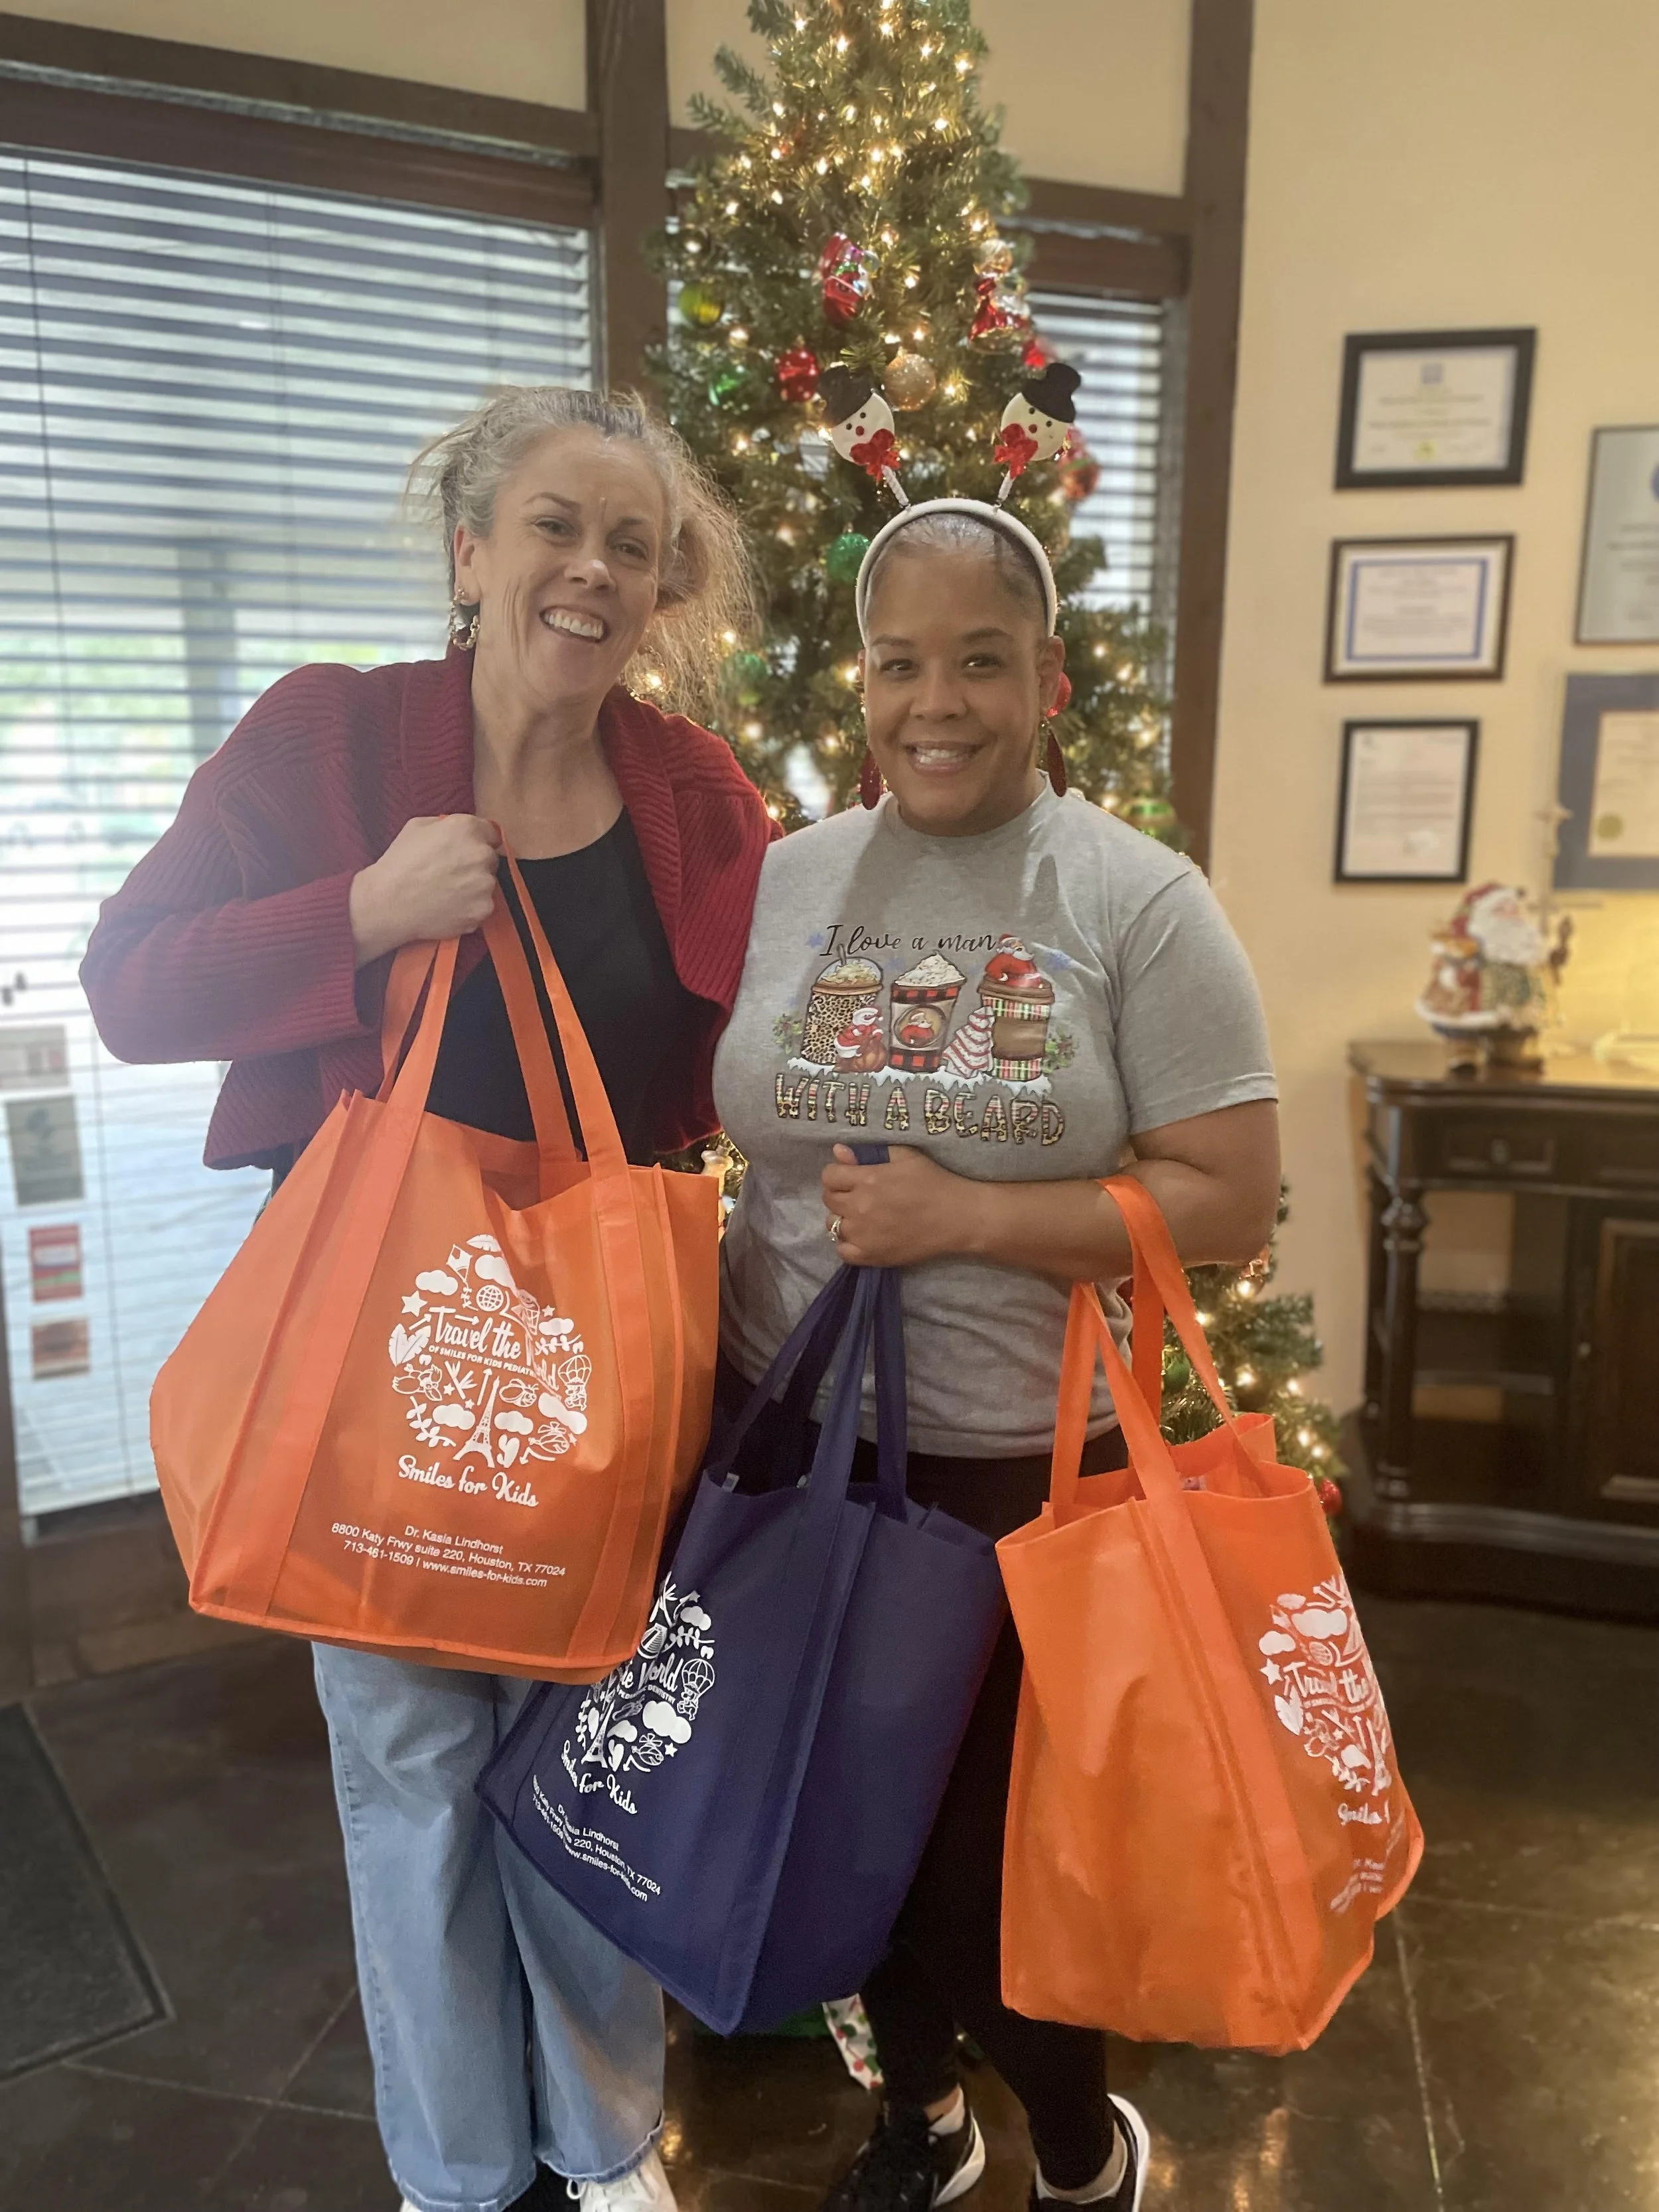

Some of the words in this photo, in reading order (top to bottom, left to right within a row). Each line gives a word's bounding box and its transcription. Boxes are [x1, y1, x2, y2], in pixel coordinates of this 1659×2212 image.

[819, 924, 847, 956] I
[847, 925, 902, 955] love
[912, 934, 928, 949] a
[938, 932, 996, 952] man
[774, 1072, 871, 1126] WITH
[885, 1087, 910, 1131] A
[924, 1088, 1065, 1146] BEARD
[429, 1306, 493, 1353] Travel
[492, 1321, 522, 1359] the
[439, 1347, 466, 1359] SMILES
[467, 1353, 483, 1364] FOR
[484, 1358, 502, 1368] KIDS
[398, 1454, 455, 1489] Smiles
[458, 1465, 488, 1495] for
[492, 1472, 539, 1507] Kids
[332, 1522, 359, 1537] 8800
[362, 1528, 385, 1546] Katy
[386, 1536, 413, 1553] Frwy
[414, 1544, 441, 1557] suite
[443, 1549, 465, 1563] 220,
[469, 1552, 514, 1572] Houston,
[518, 1562, 533, 1573] TX
[535, 1564, 566, 1577] 77024
[405, 1525, 419, 1538] Dr.
[423, 1529, 452, 1544] Kasia
[455, 1536, 504, 1554] Lindhorst
[423, 1560, 547, 1587] www.smiles-for-kids.com
[579, 1773, 605, 1793] for
[607, 1774, 637, 1814] Kids
[583, 1827, 619, 1851] Lindhorst
[573, 1838, 593, 1852] 220,
[636, 1874, 661, 1895] 77024
